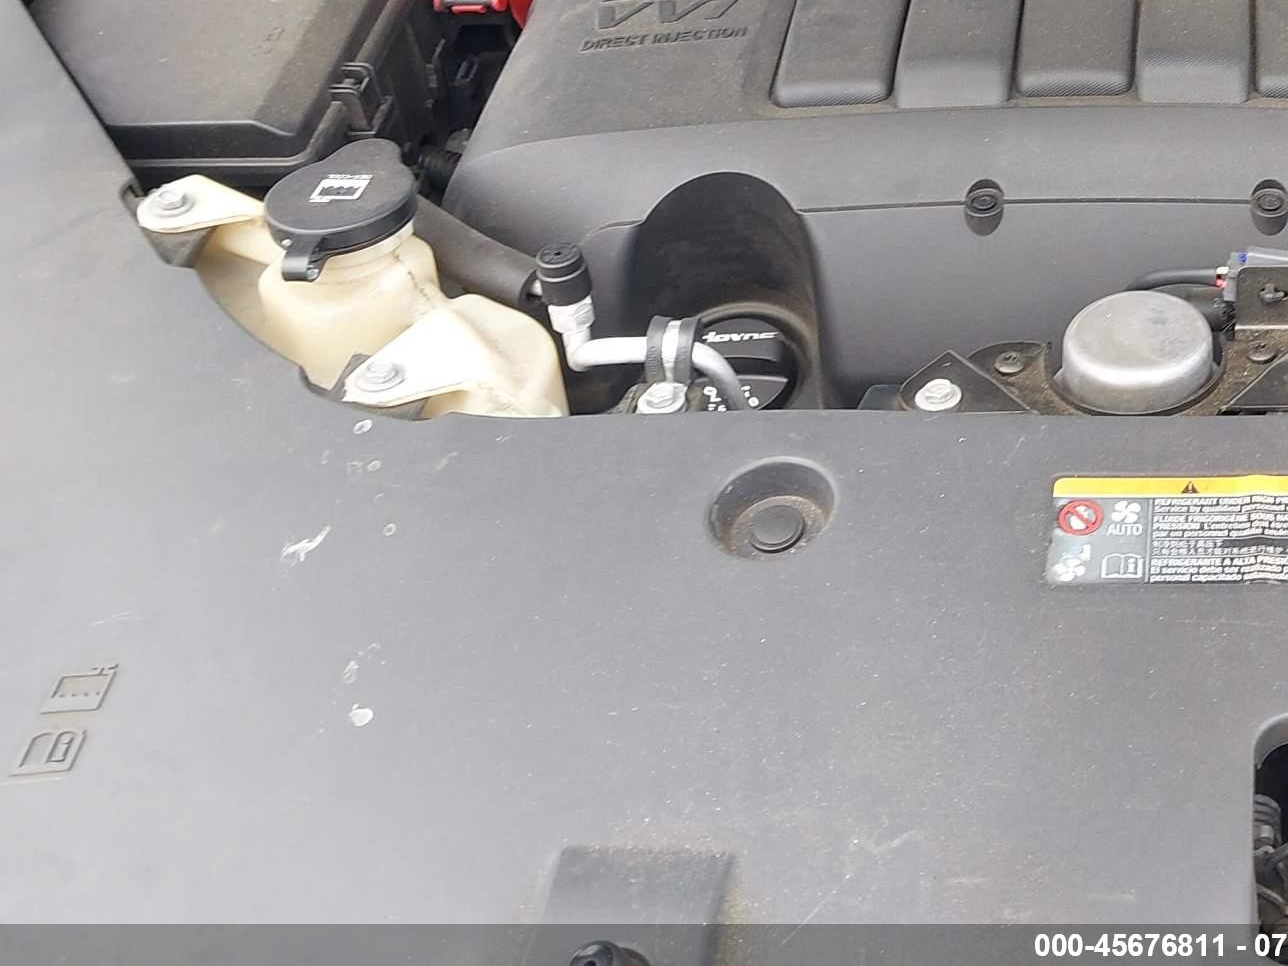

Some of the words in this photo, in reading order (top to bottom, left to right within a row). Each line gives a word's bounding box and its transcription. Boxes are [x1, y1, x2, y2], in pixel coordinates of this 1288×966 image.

[579, 33, 650, 53] DIRECT
[651, 26, 750, 46] INJECTION
[1154, 498, 1218, 506] REFRIGERANT
[1106, 523, 1142, 536] AUTO
